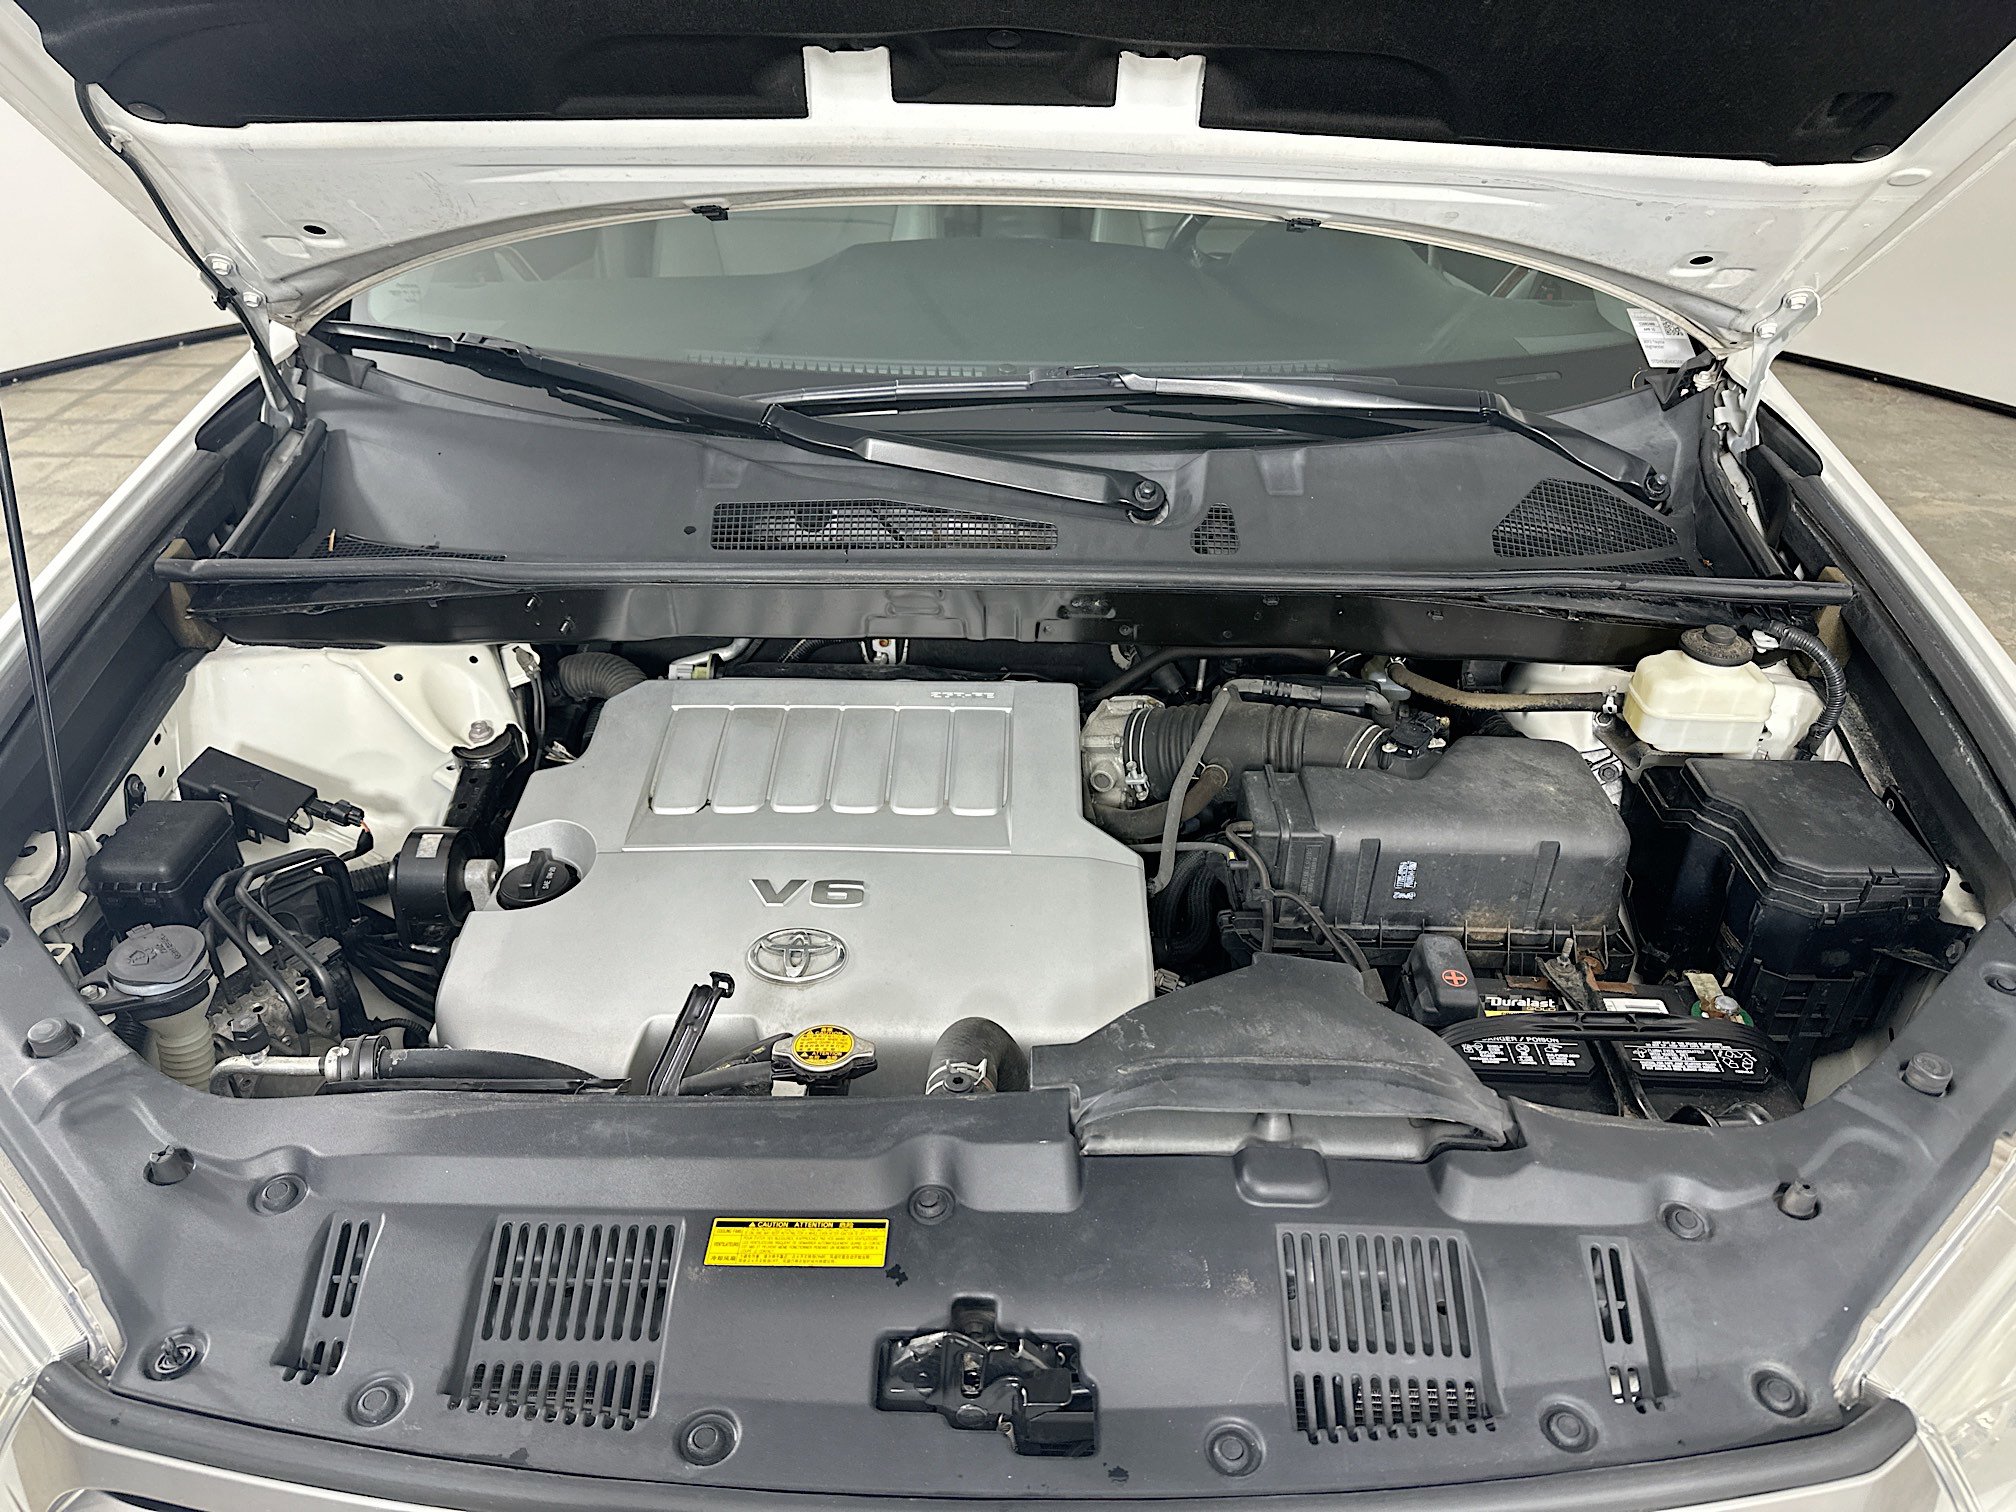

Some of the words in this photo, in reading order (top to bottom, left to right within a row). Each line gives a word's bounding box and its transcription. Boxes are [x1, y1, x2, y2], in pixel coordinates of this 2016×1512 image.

[748, 878, 865, 909] V6
[1486, 997, 1556, 1007] Duralast
[757, 1221, 790, 1229] CAUTION
[793, 1221, 835, 1229] ATTENTION
